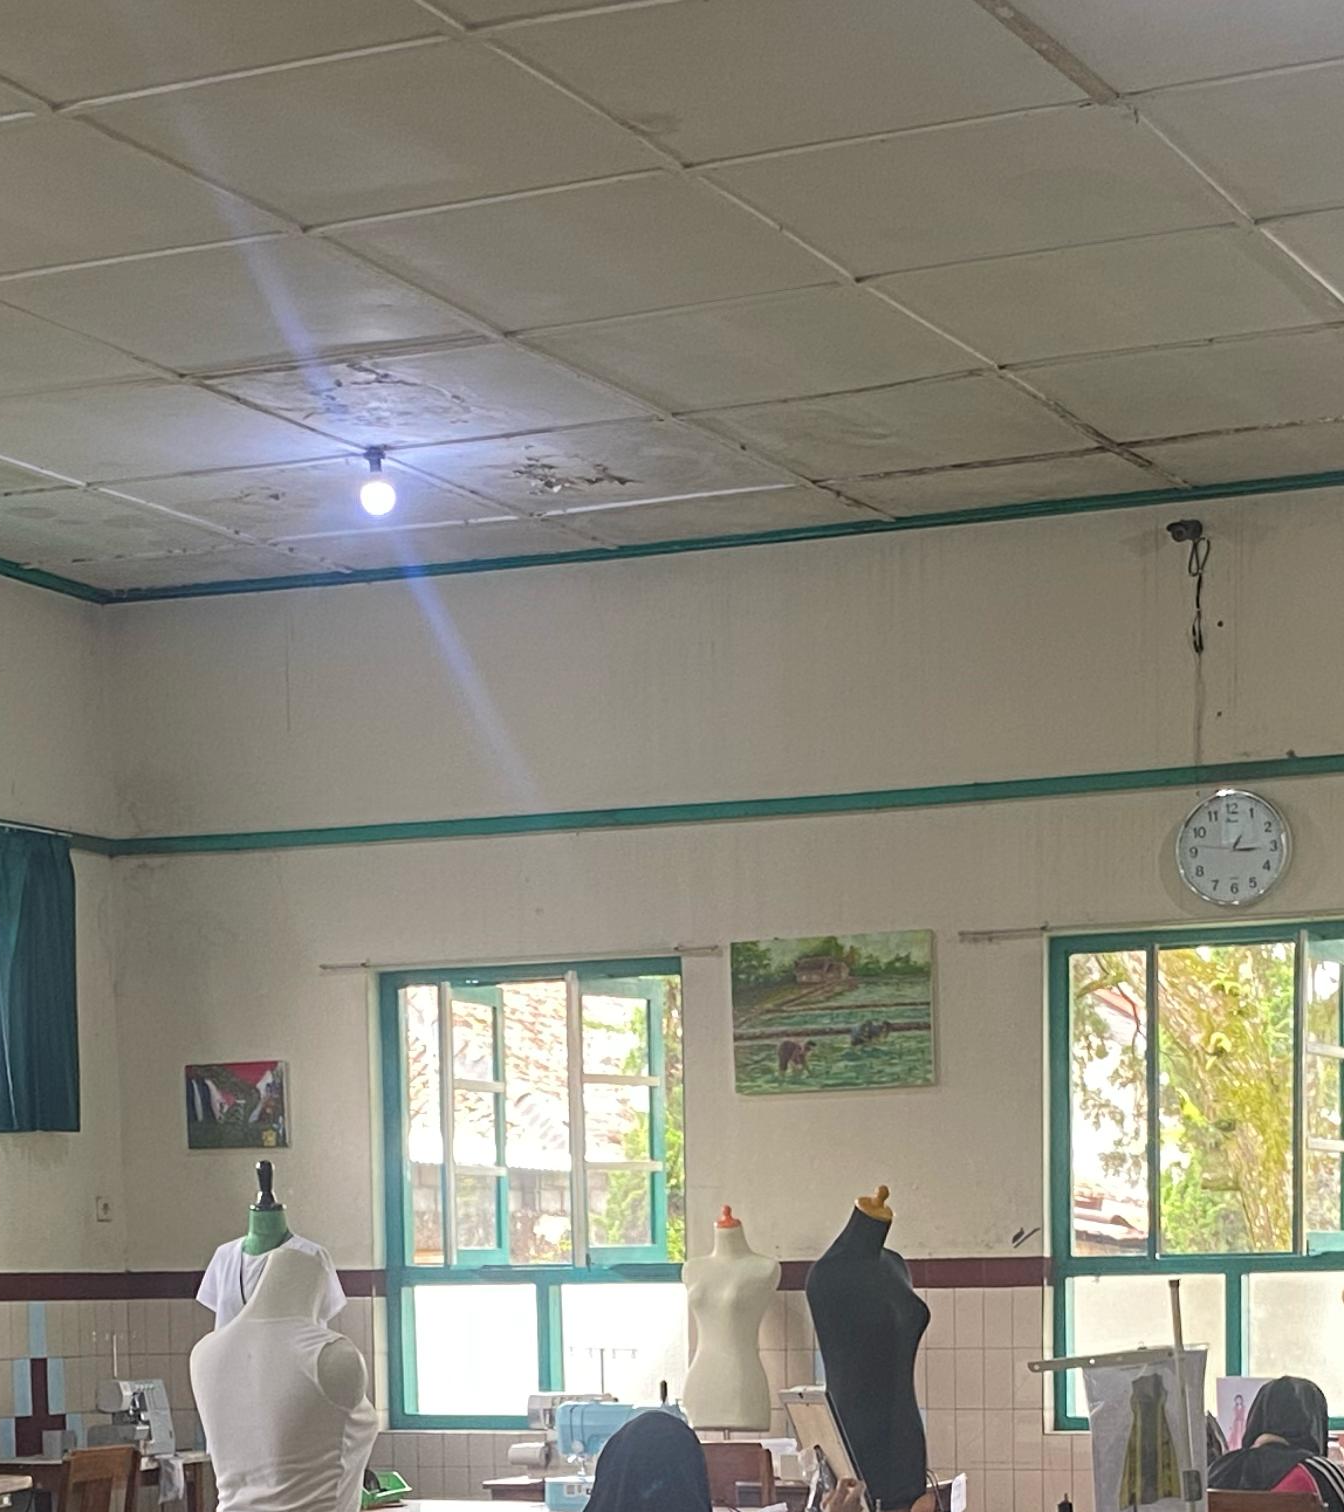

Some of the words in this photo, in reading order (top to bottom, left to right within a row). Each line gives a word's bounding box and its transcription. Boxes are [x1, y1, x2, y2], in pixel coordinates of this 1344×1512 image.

[1226, 803, 1239, 814] 12
[1249, 807, 1255, 819] 1
[1208, 811, 1218, 822] 11
[1193, 826, 1207, 838] 10
[1264, 821, 1272, 833] 2
[1270, 840, 1278, 852] 3
[1189, 847, 1198, 858] 9
[1262, 859, 1271, 871] 4
[1196, 865, 1204, 877] 8
[1211, 880, 1219, 891] 7
[1249, 877, 1257, 888] 5
[1230, 883, 1239, 894] 6
